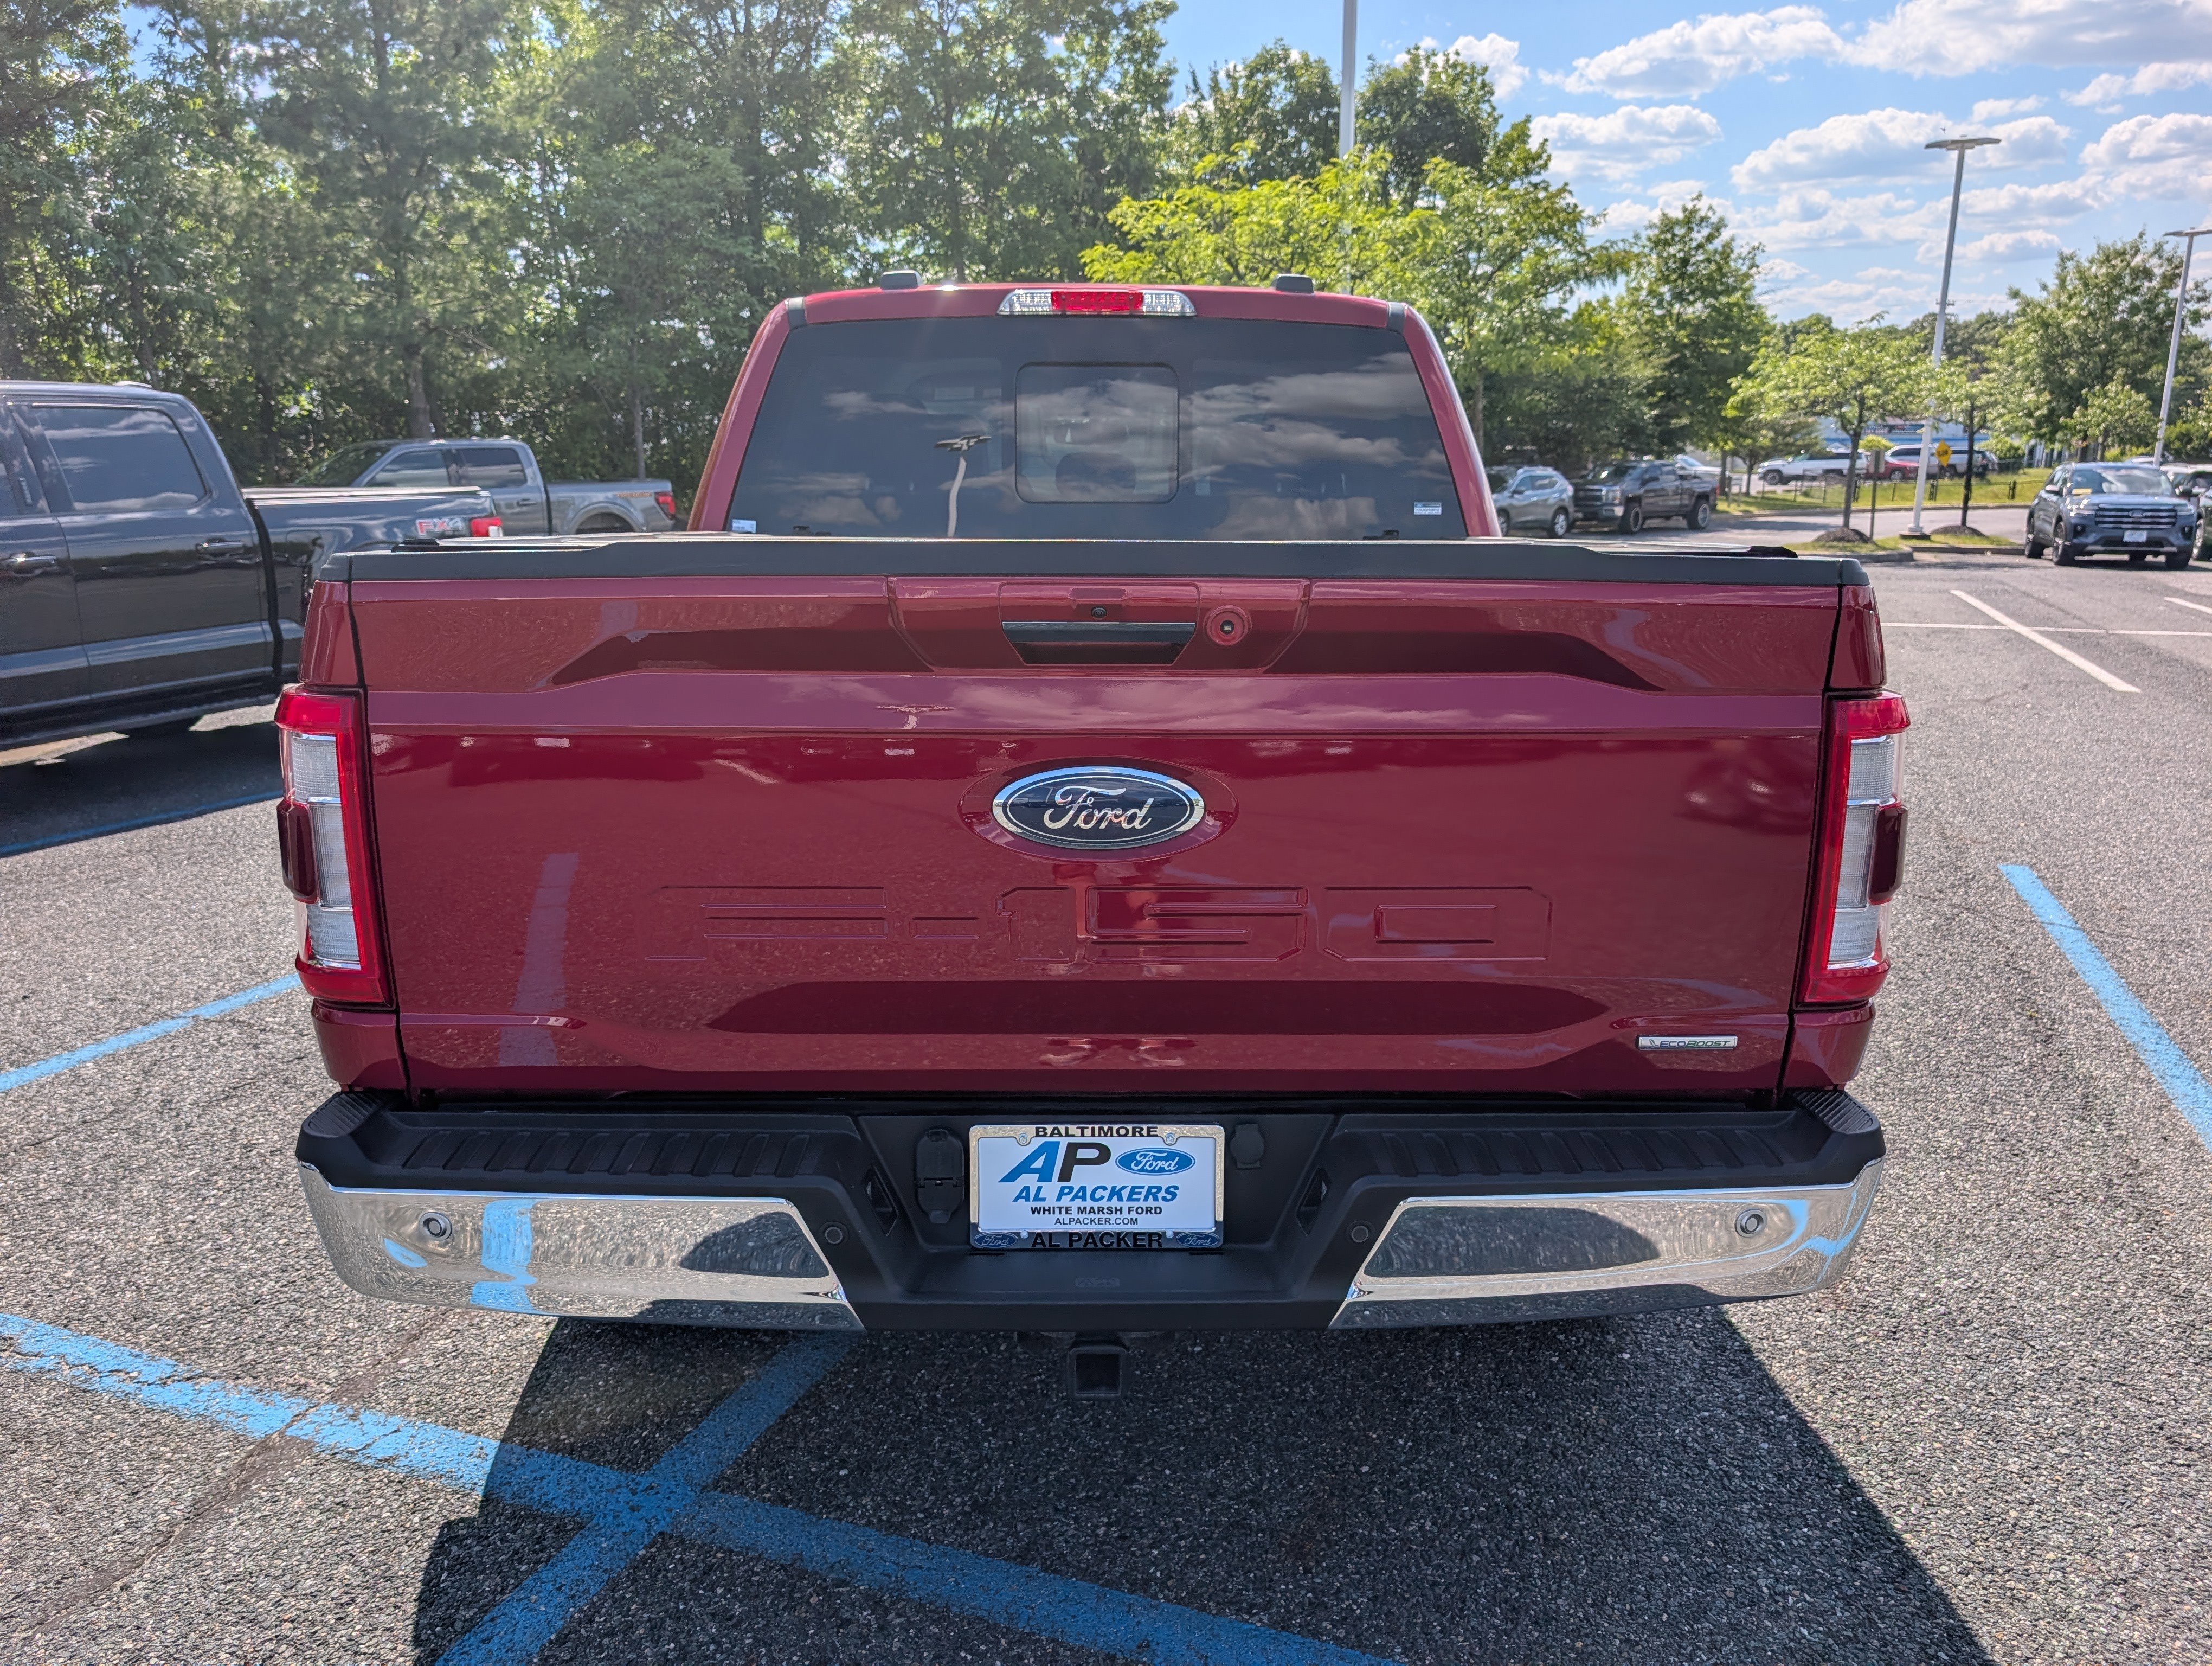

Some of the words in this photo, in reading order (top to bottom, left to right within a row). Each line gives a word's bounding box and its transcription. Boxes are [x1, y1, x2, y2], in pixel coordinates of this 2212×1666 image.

[416, 517, 463, 535] FX4
[1043, 785, 1152, 830] Ford
[640, 885, 1553, 964] F-150
[1034, 1126, 1158, 1137] BALTIMORE
[998, 1140, 1111, 1183] AP
[1131, 1151, 1179, 1171] Ford
[1012, 1185, 1047, 1202] AL
[1055, 1184, 1180, 1202] PACKERS
[1030, 1206, 1073, 1215] WHITE
[1077, 1206, 1124, 1215] MARSH
[1128, 1206, 1162, 1215] FORD
[1054, 1217, 1139, 1226] ALPACKER.COM
[982, 1234, 1010, 1246] Ford
[1031, 1231, 1060, 1247] AL
[1068, 1231, 1162, 1247] PACKER
[1184, 1234, 1212, 1245] Ford
